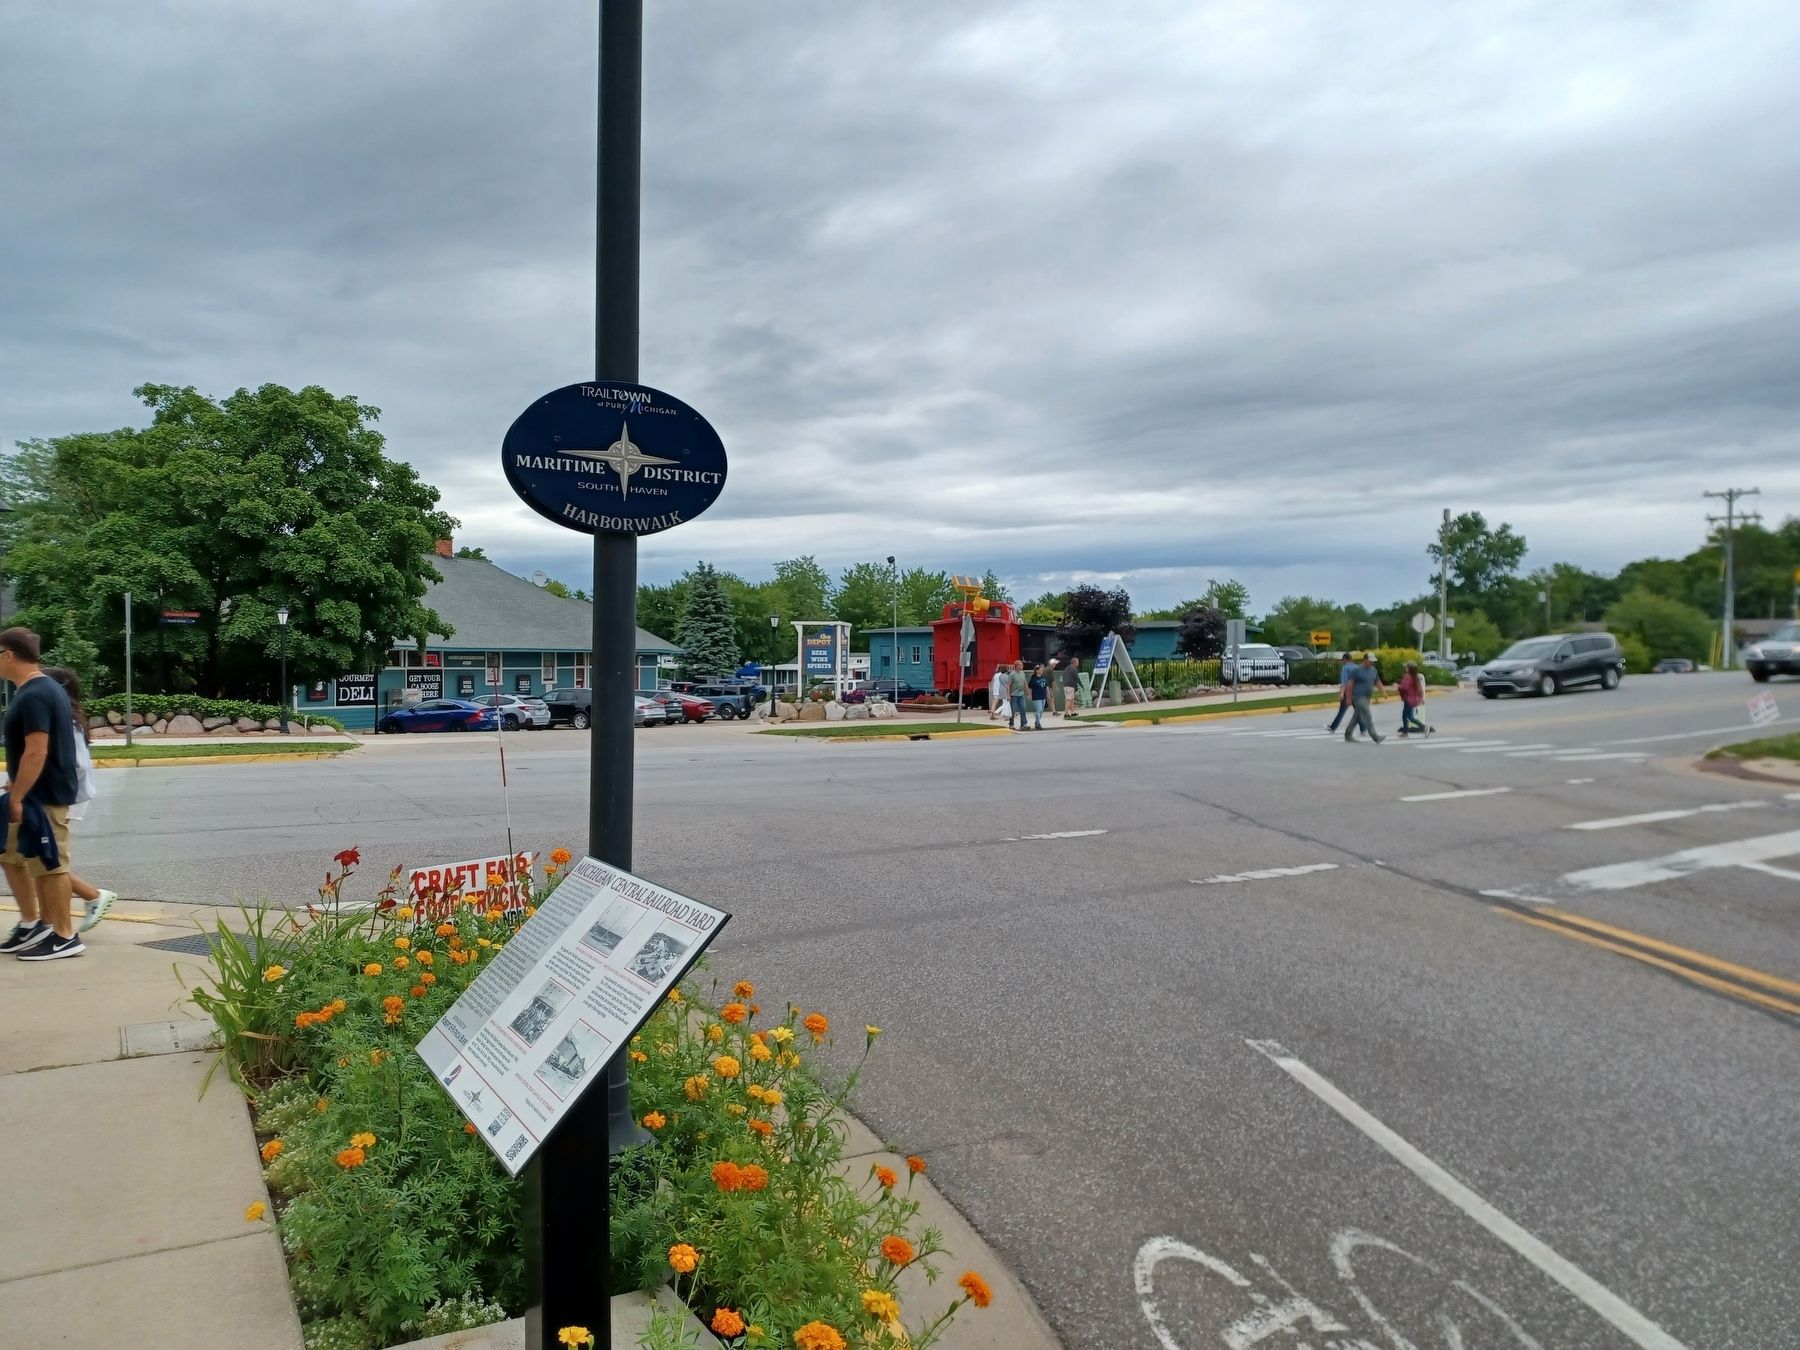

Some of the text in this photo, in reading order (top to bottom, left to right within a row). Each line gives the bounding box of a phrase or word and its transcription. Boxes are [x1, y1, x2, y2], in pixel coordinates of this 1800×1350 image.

[605, 401, 627, 410] PURE
[516, 454, 722, 484] MARITIME DISTRICT
[577, 481, 668, 496] SOUTH HAVEN
[562, 503, 682, 531] HARBORWALK
[408, 674, 441, 682] GET YOUR
[338, 686, 375, 701] DELI
[420, 690, 439, 698] HERE
[414, 863, 479, 895] CRAFT
[574, 862, 617, 888] MICHIGAN
[610, 877, 649, 902] CENTRAL
[641, 889, 690, 920] RAILROAD
[684, 907, 716, 932] YARD
